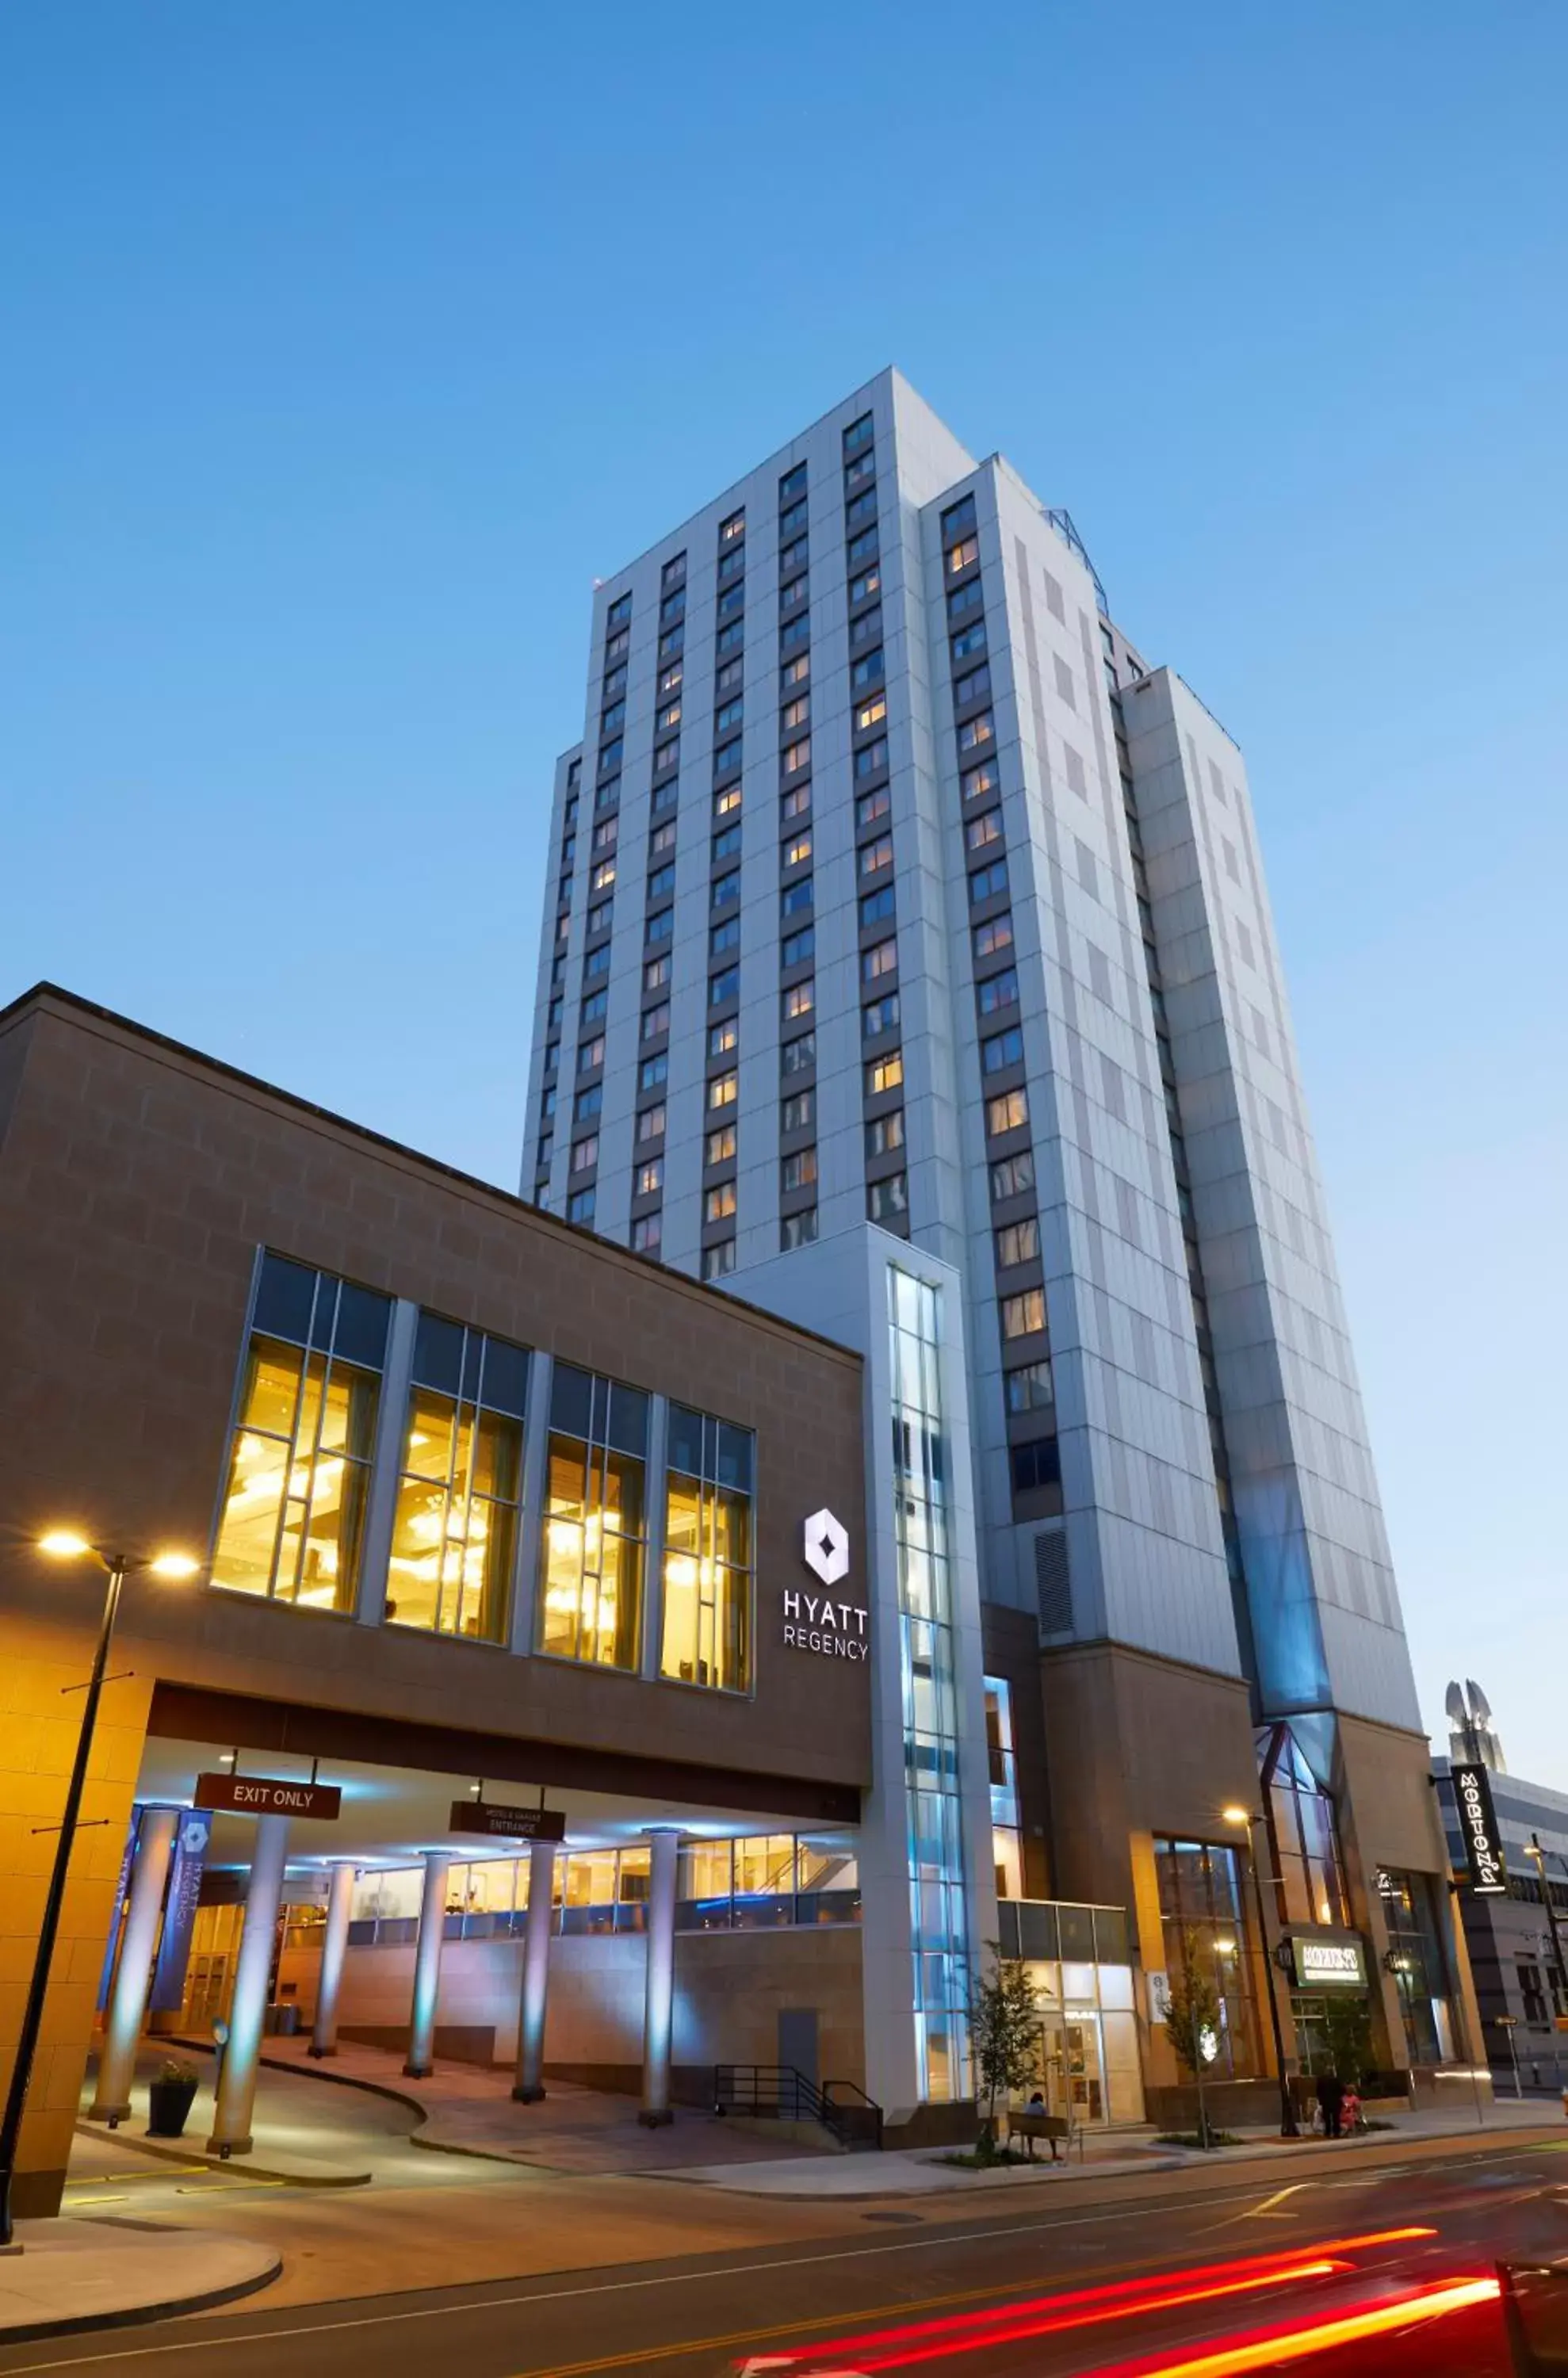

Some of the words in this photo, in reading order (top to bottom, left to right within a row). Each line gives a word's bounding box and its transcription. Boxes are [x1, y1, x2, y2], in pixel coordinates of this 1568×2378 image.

[784, 1589, 868, 1635] HYATT
[784, 1625, 868, 1661] REGENCY
[234, 1785, 270, 1803] EXIT
[273, 1789, 313, 1807] ONLY
[189, 1862, 204, 1911] HYATT
